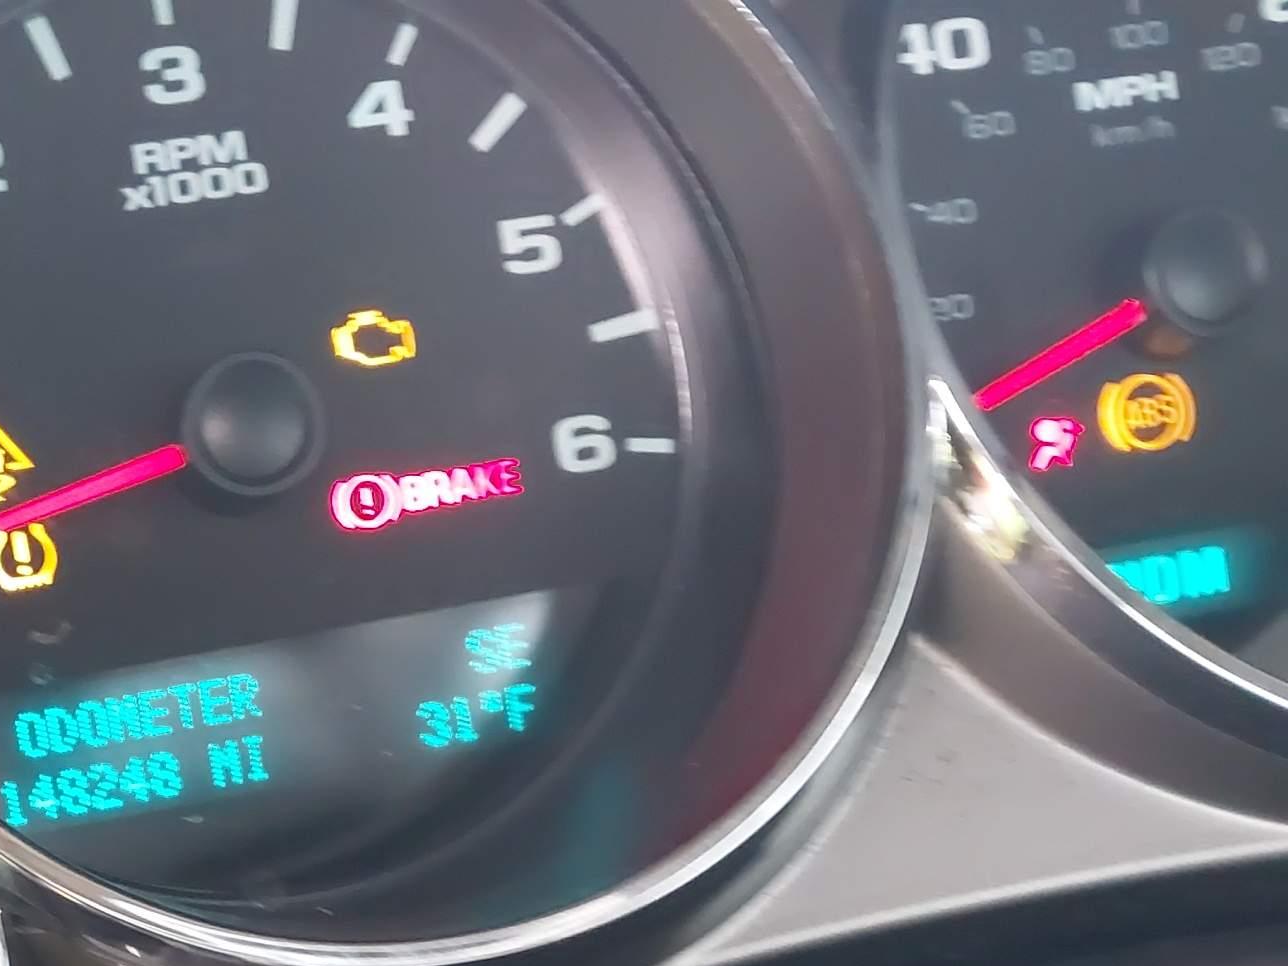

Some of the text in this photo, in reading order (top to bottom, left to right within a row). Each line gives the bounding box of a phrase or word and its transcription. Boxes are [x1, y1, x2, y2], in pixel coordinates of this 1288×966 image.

[139, 45, 206, 104] 3
[897, 17, 992, 75] 40
[347, 80, 414, 136] 4
[1072, 70, 1180, 111] MPH
[130, 130, 248, 175] RPM
[120, 162, 269, 211] x1000
[497, 215, 562, 274] 5
[552, 415, 616, 472] 6
[398, 458, 524, 512] BRAKE
[15, 673, 263, 758] ODOMETER
[416, 683, 536, 747] 31°F
[0, 735, 269, 827] 148248 MI
